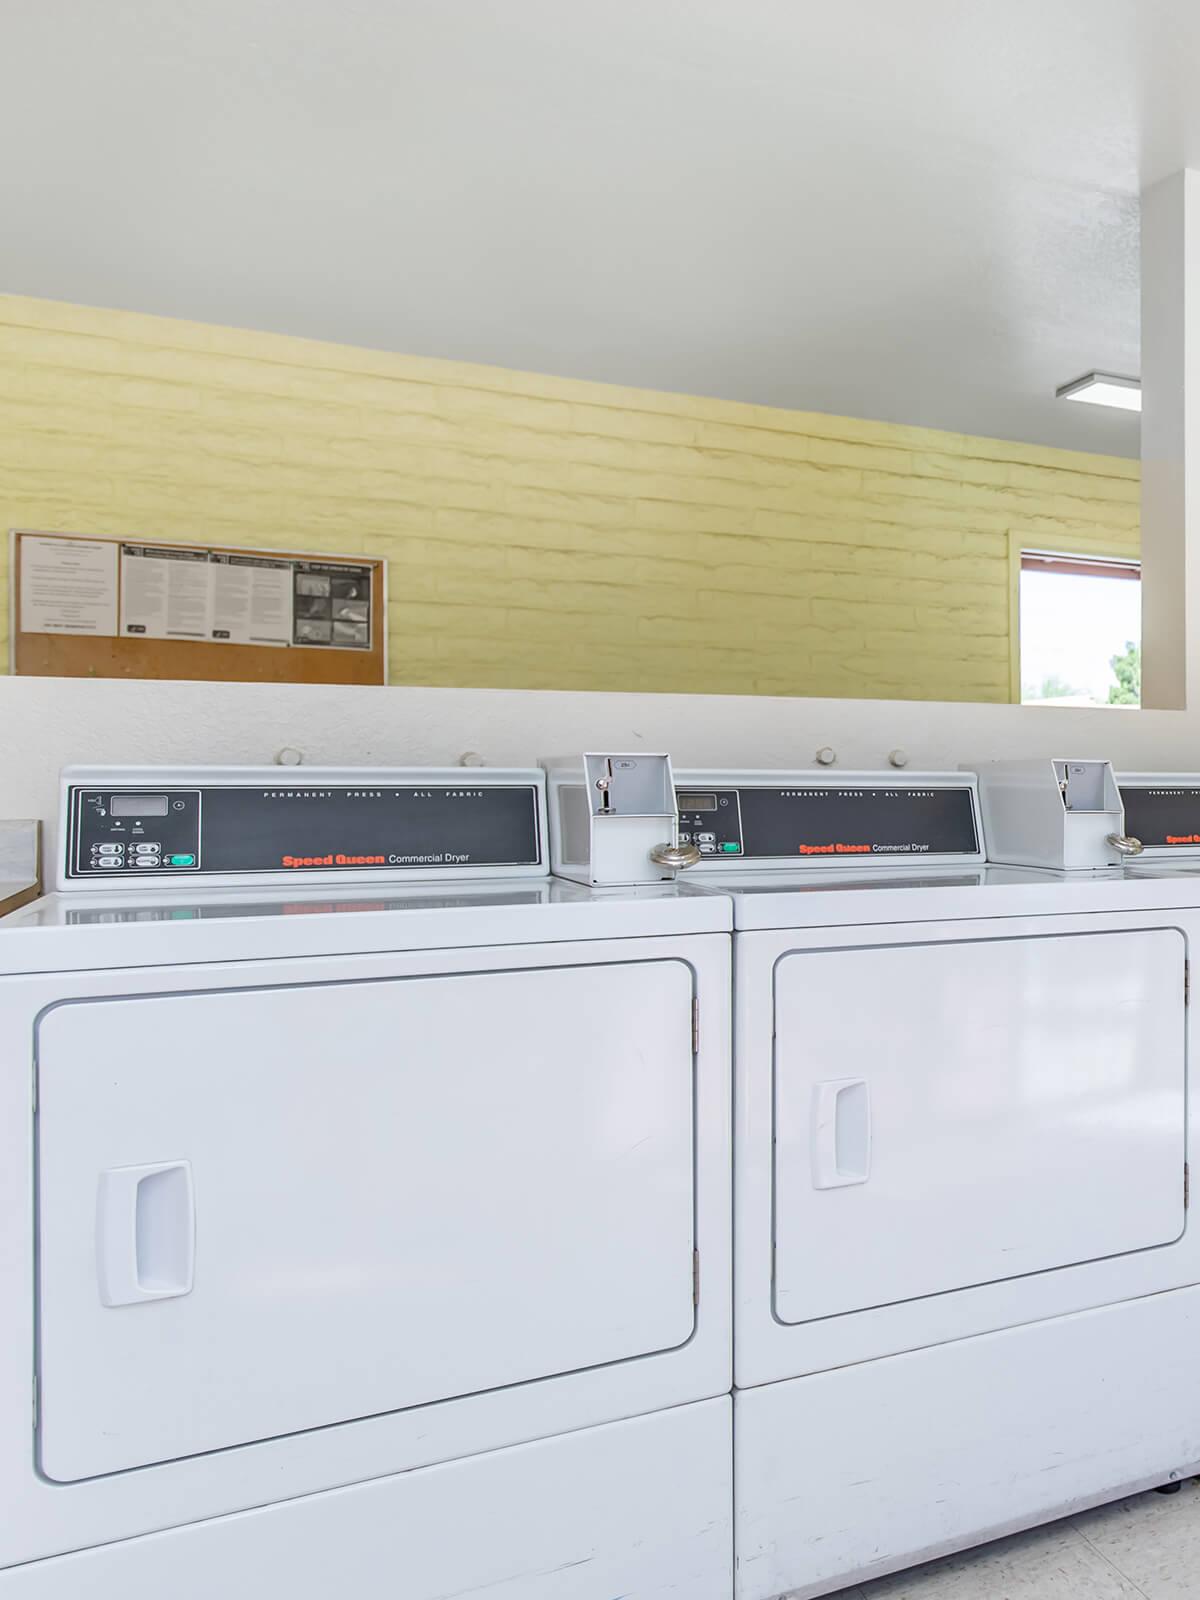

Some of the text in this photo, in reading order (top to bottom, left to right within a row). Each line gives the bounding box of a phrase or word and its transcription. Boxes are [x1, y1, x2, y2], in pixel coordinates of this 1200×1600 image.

[1166, 834, 1193, 844] Speed
[799, 843, 929, 855] Speed Queen Commercial Dryer
[282, 852, 470, 868] Speed Queen Commercial Dryer
